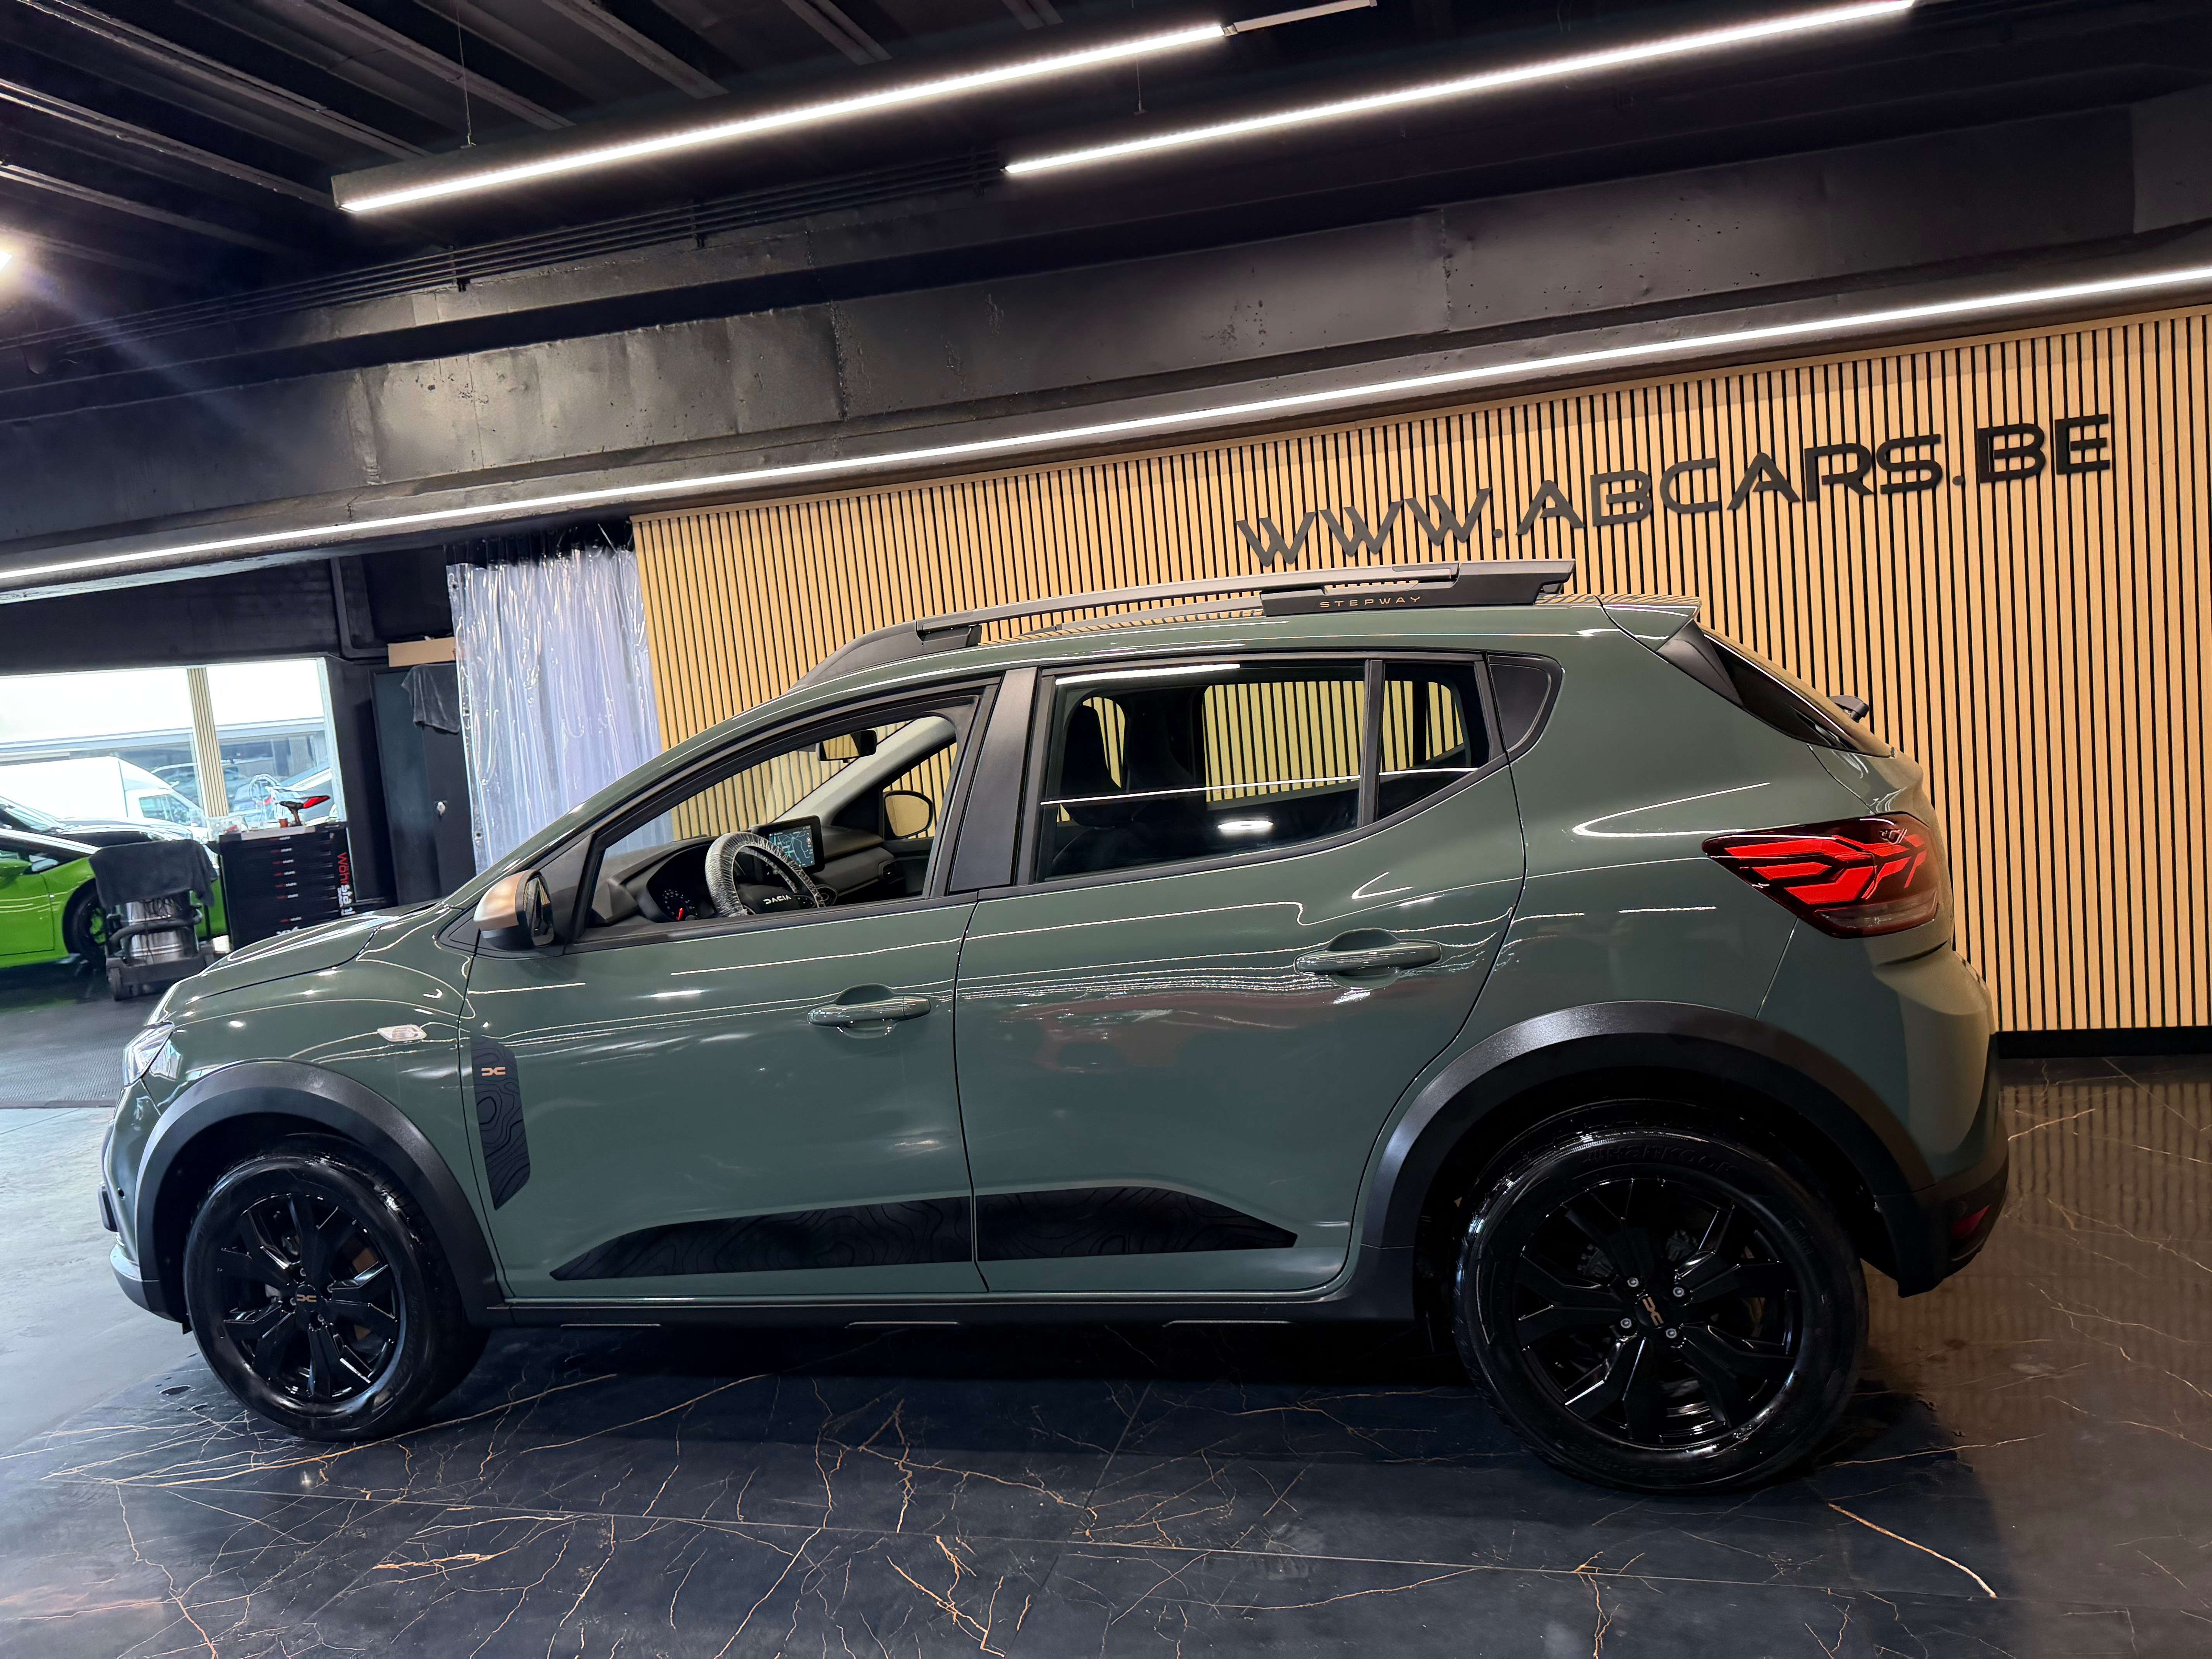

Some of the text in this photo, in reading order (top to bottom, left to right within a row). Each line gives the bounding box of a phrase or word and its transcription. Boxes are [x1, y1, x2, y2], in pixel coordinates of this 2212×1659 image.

[1236, 414, 2110, 567] WWW.ABCARS.BE
[1320, 596, 1420, 608] STEPWAY
[763, 895, 792, 905] DACIA
